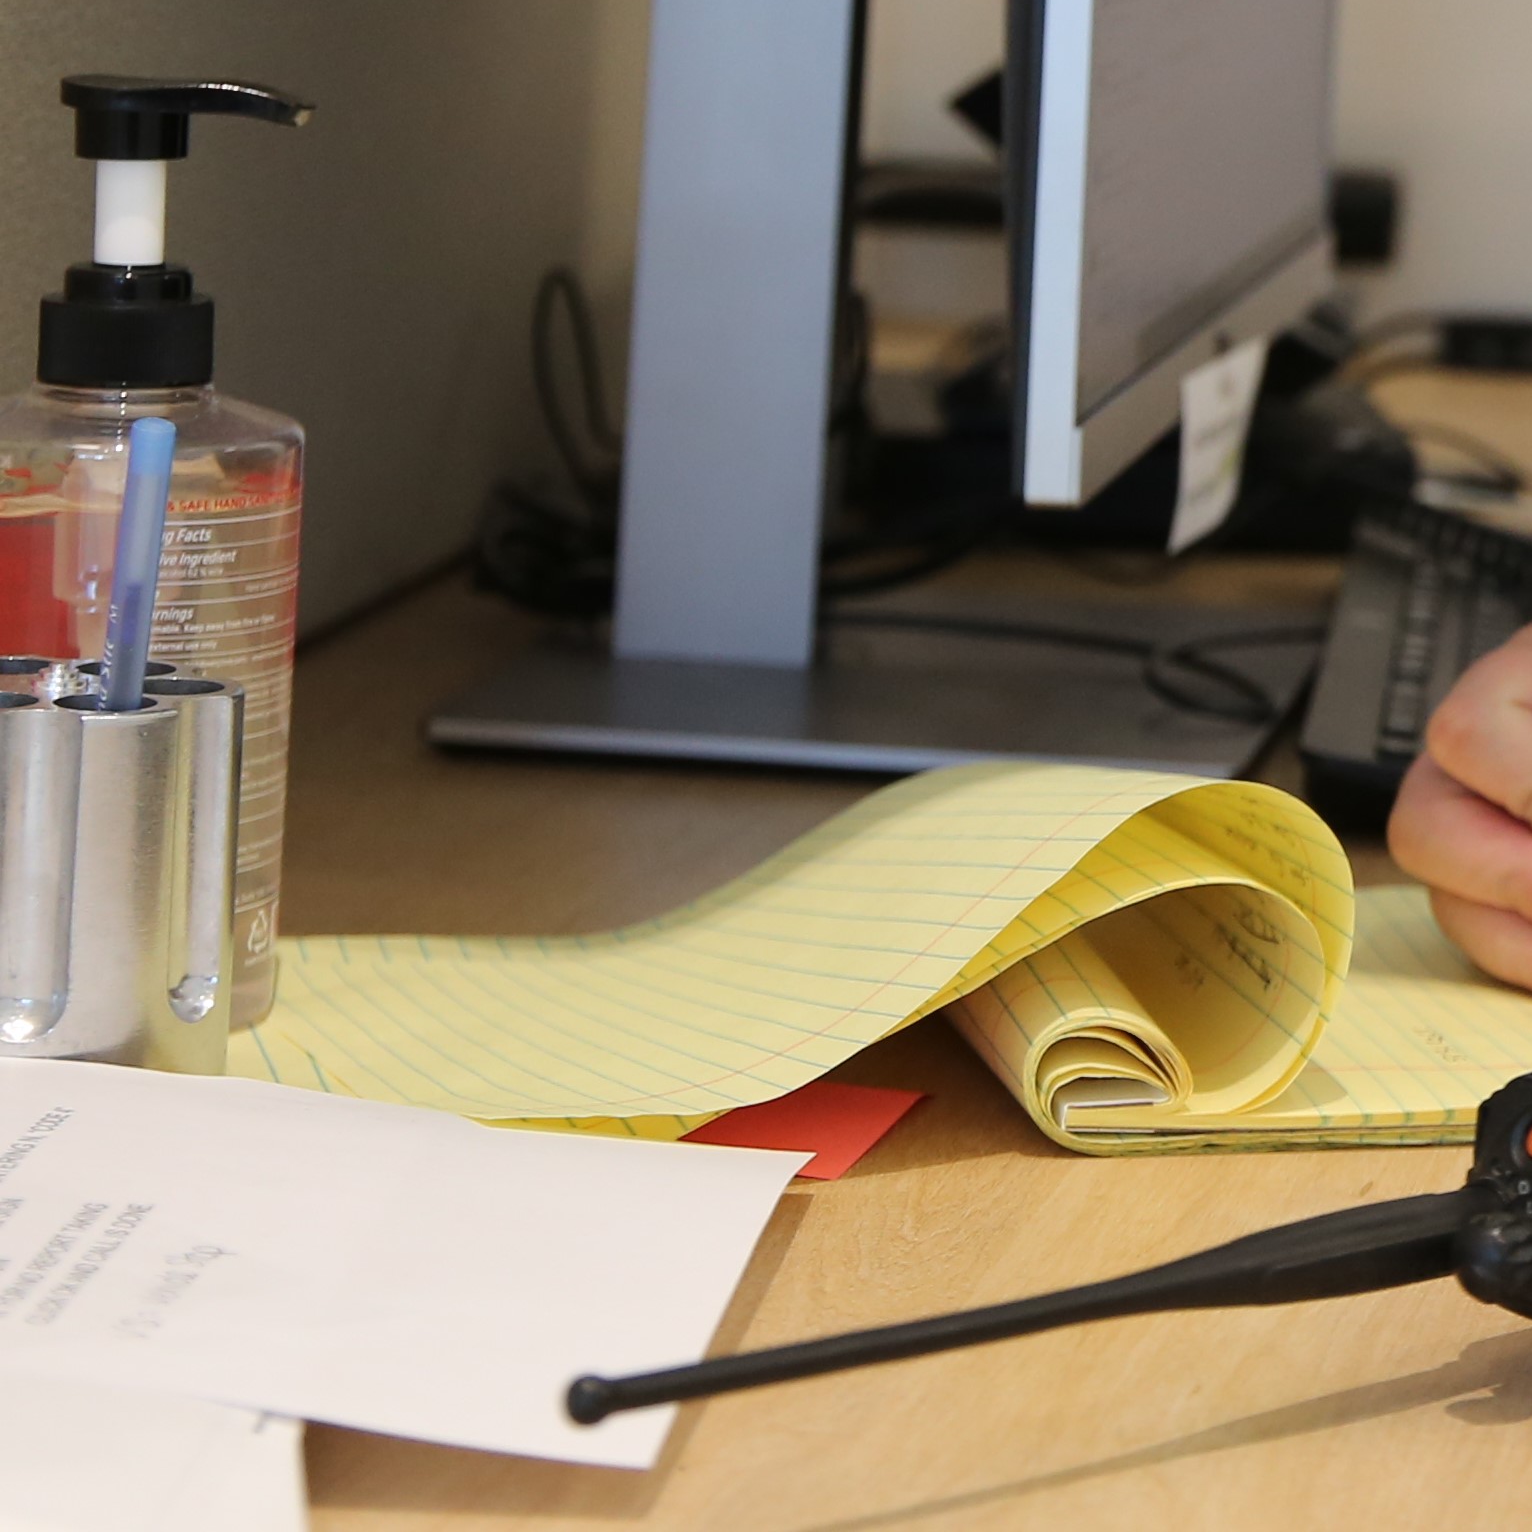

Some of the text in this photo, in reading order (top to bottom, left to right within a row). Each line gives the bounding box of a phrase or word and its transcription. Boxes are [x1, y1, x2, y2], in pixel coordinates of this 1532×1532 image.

[180, 499, 209, 511] SAFE
[176, 528, 212, 543] Facts
[179, 550, 237, 568] Ingredient
